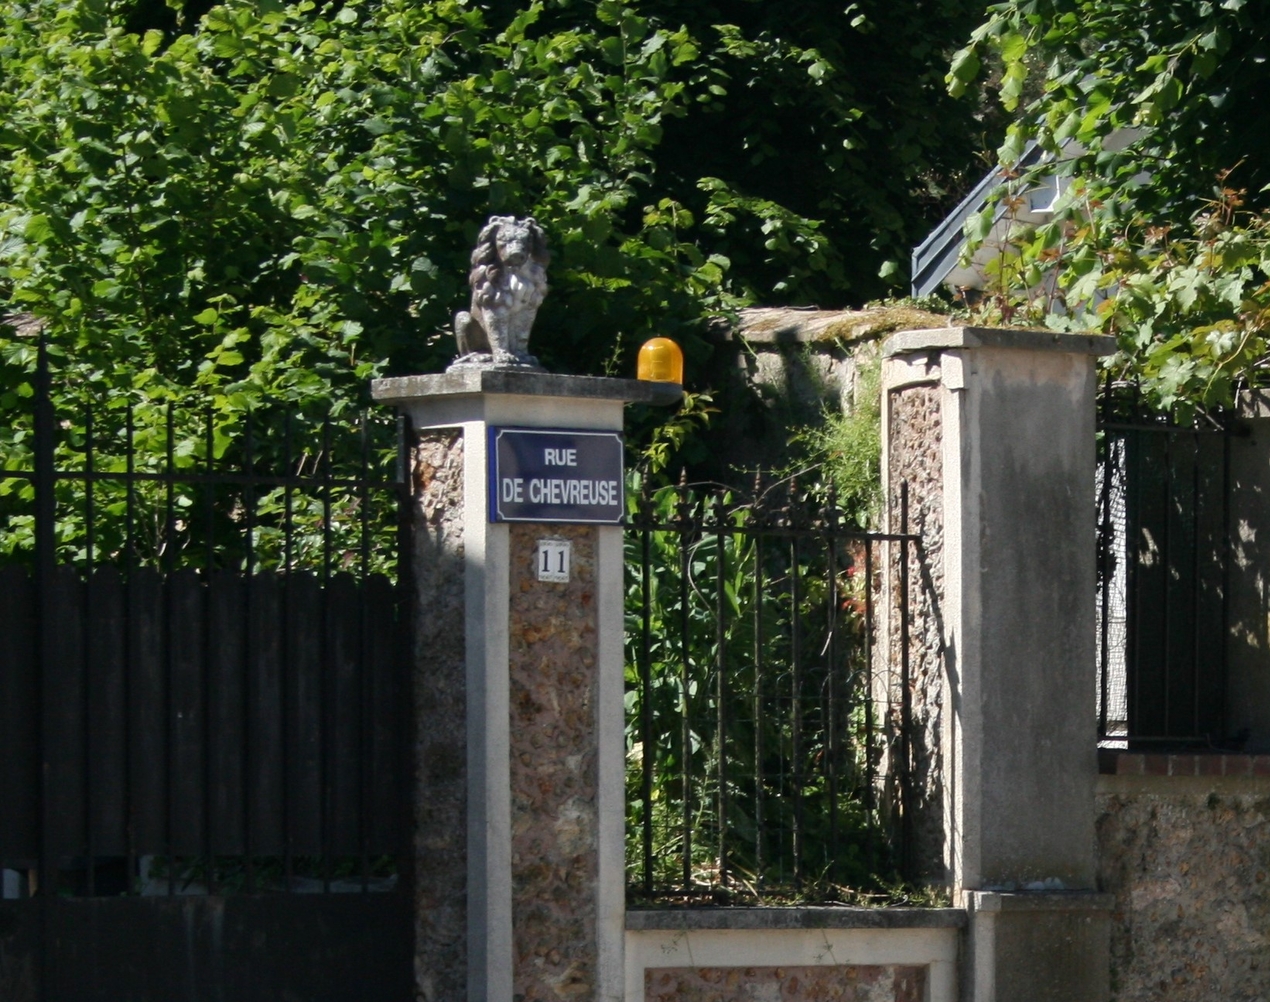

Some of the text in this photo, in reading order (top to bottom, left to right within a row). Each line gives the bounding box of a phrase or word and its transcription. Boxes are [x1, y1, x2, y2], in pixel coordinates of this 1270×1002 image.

[544, 448, 578, 466] RUE
[503, 478, 618, 505] DE CHEVREUSE
[541, 549, 566, 573] 11
